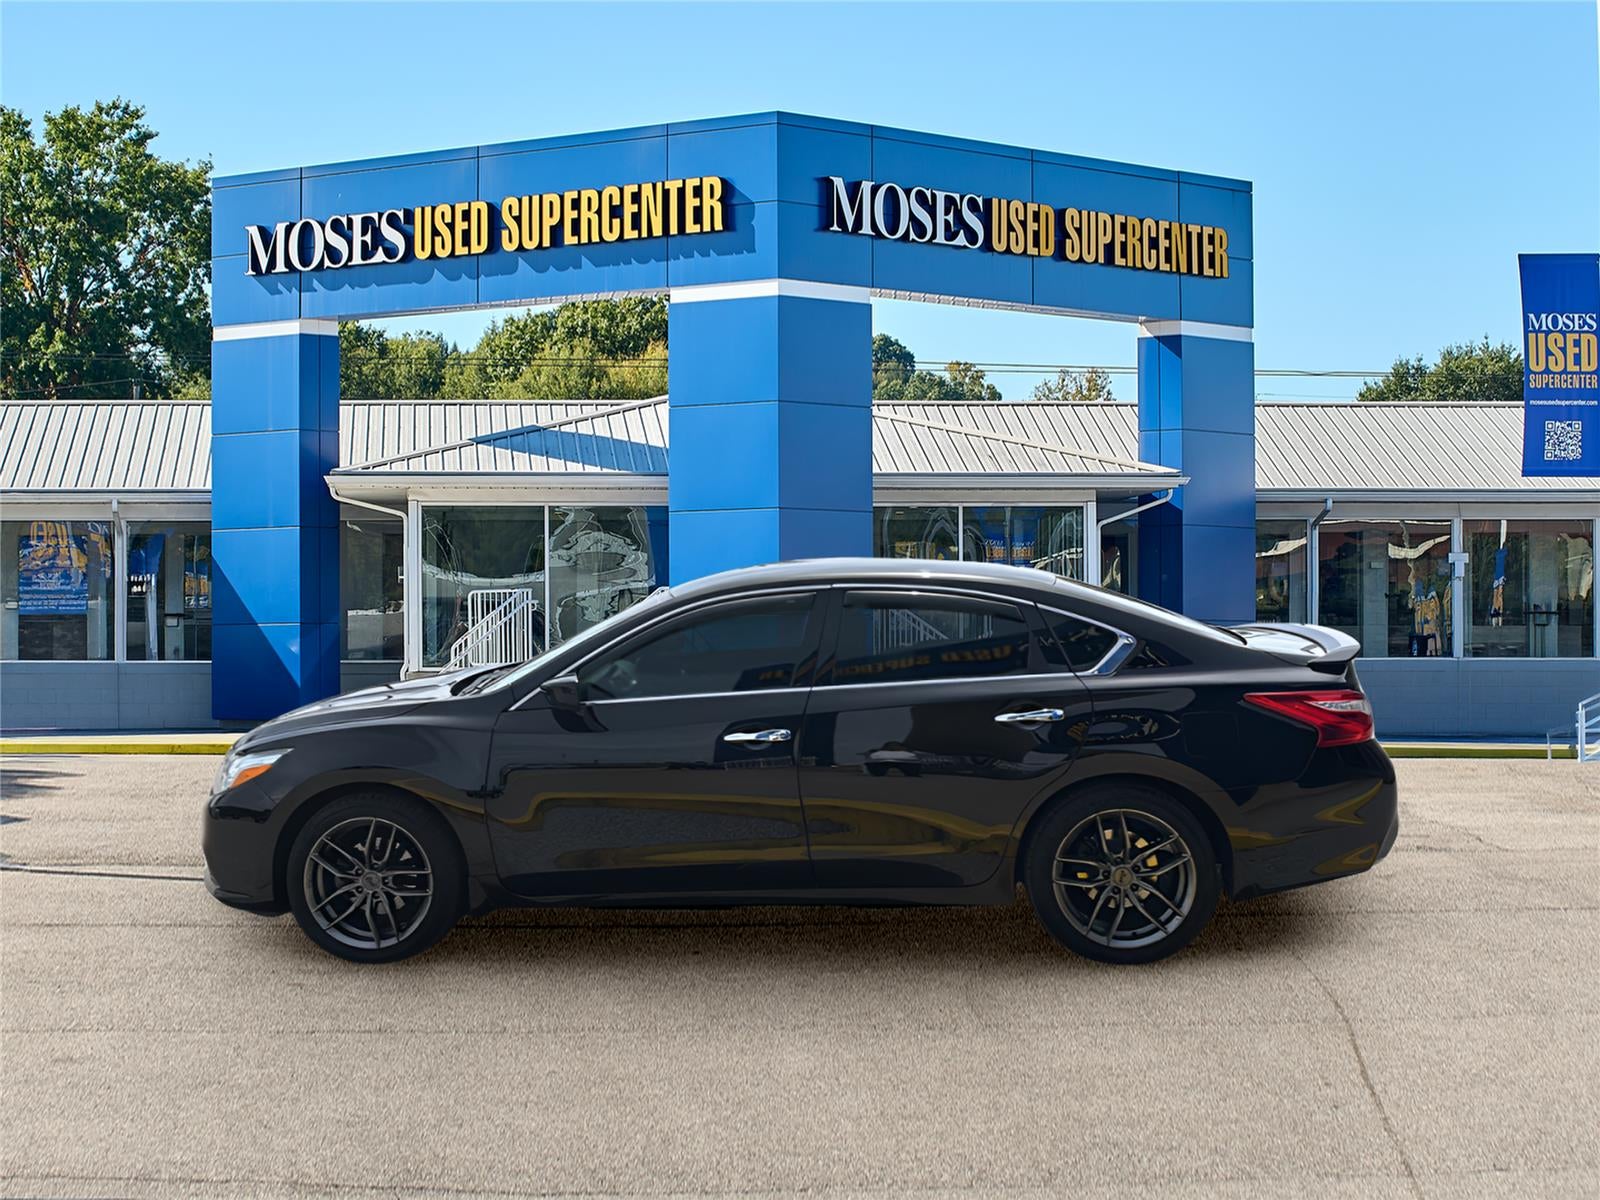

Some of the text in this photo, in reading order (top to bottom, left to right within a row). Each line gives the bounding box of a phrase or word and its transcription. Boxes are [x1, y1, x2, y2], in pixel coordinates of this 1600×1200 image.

[244, 176, 725, 276] MOSES USED SUPERCENTER
[828, 175, 1230, 279] MOSES USED SUPERCENTER
[1528, 313, 1597, 332] MOSES
[1528, 333, 1598, 373] USED
[1529, 374, 1598, 389] SUPERCENTER
